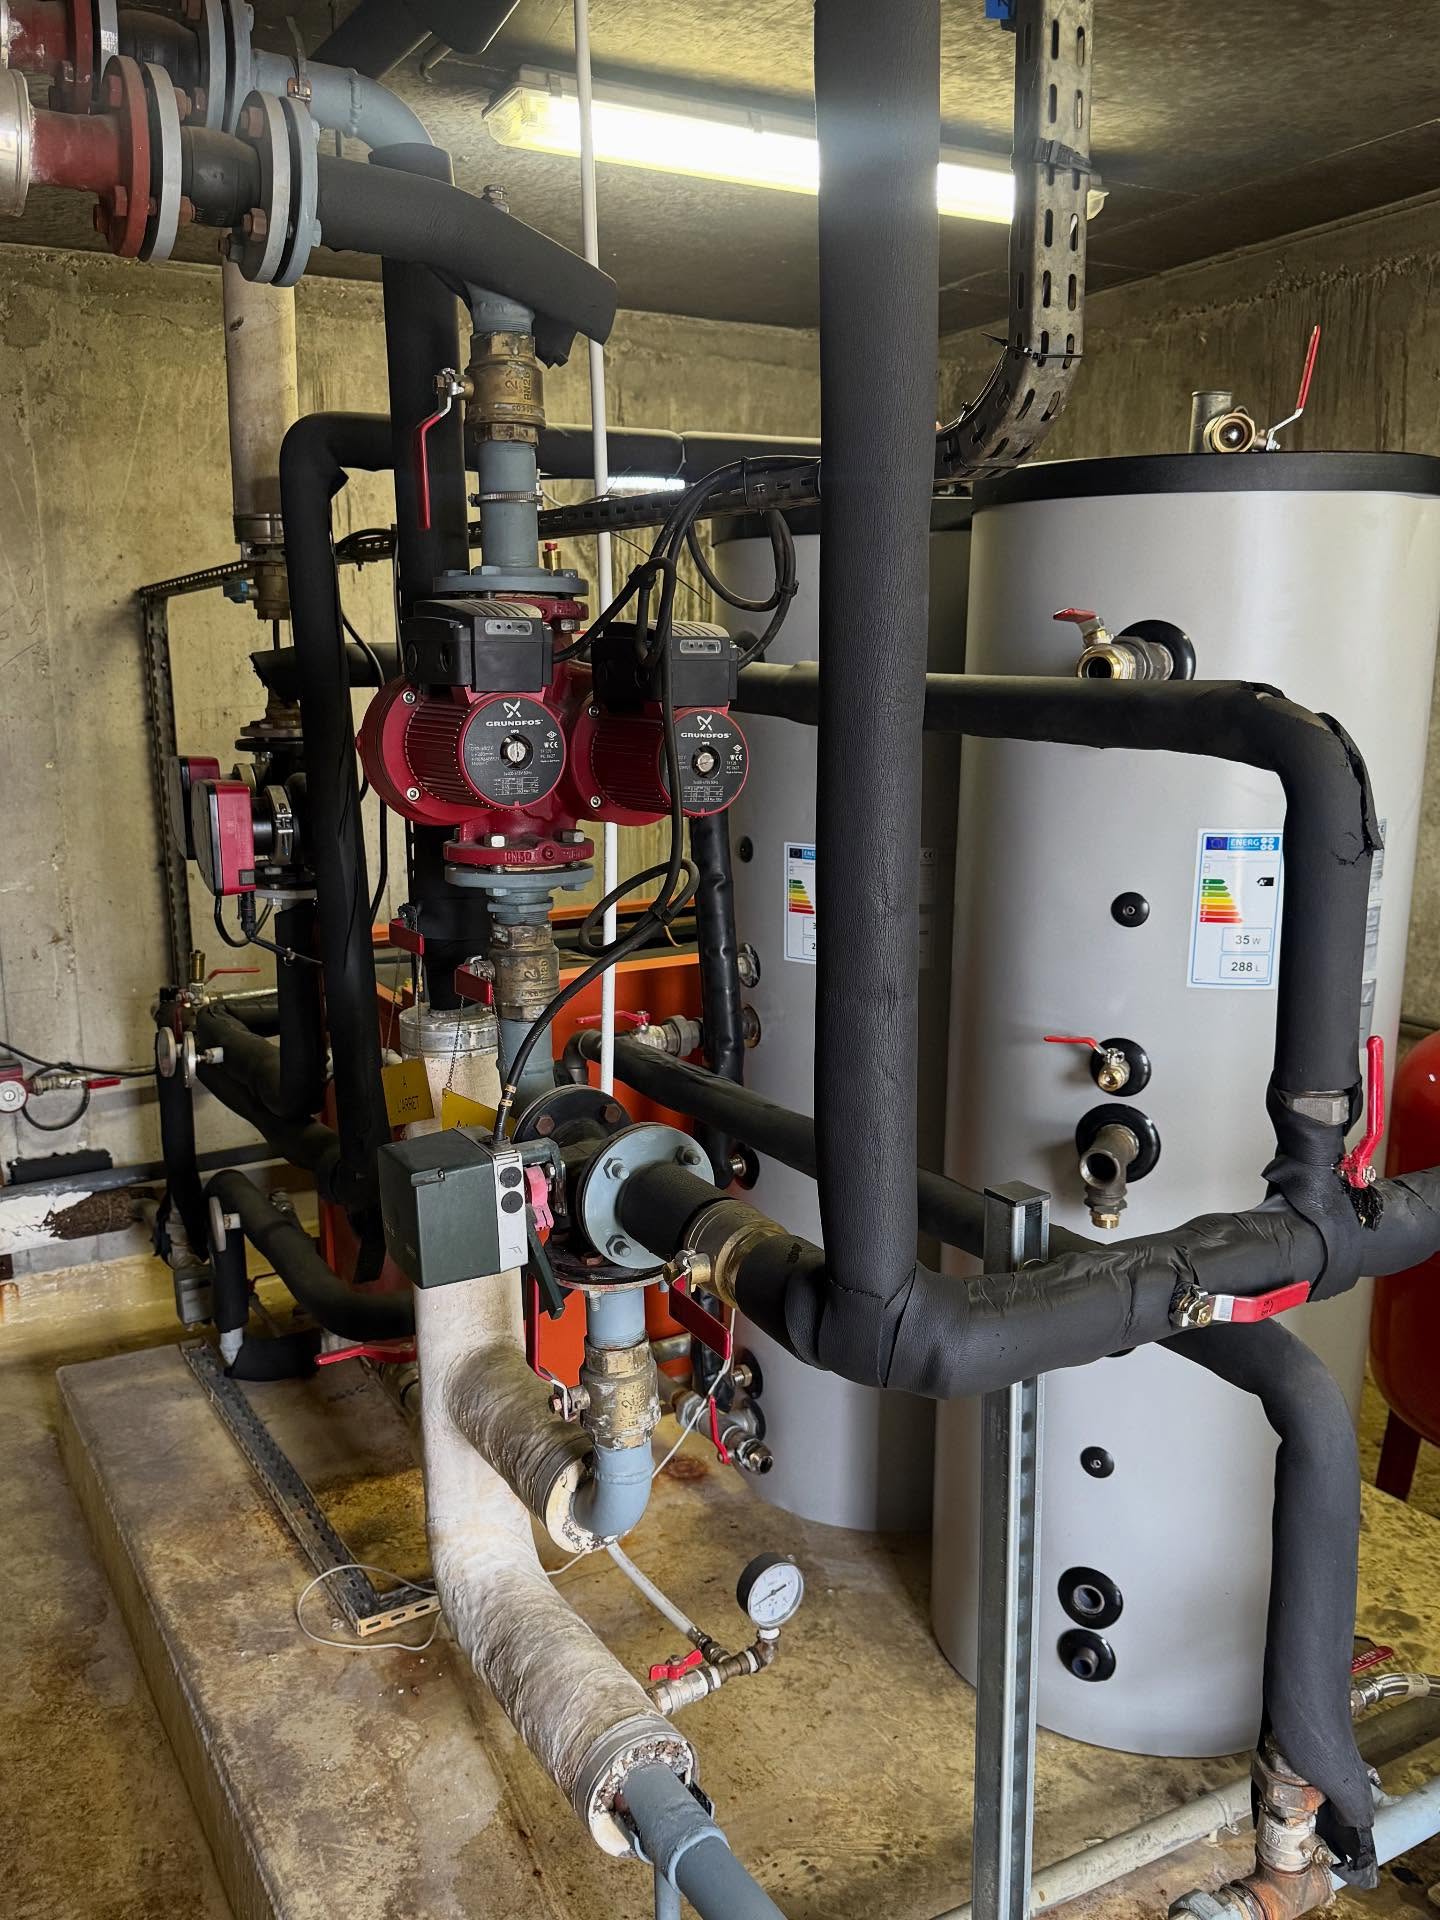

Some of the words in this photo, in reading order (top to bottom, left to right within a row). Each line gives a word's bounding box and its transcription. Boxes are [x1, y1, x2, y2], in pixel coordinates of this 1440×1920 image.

[485, 719, 541, 727] GRUNDFOS
[1230, 838, 1260, 847] ENERG
[1235, 935, 1250, 945] 35
[1252, 937, 1261, 945] W
[1231, 962, 1253, 972] 288
